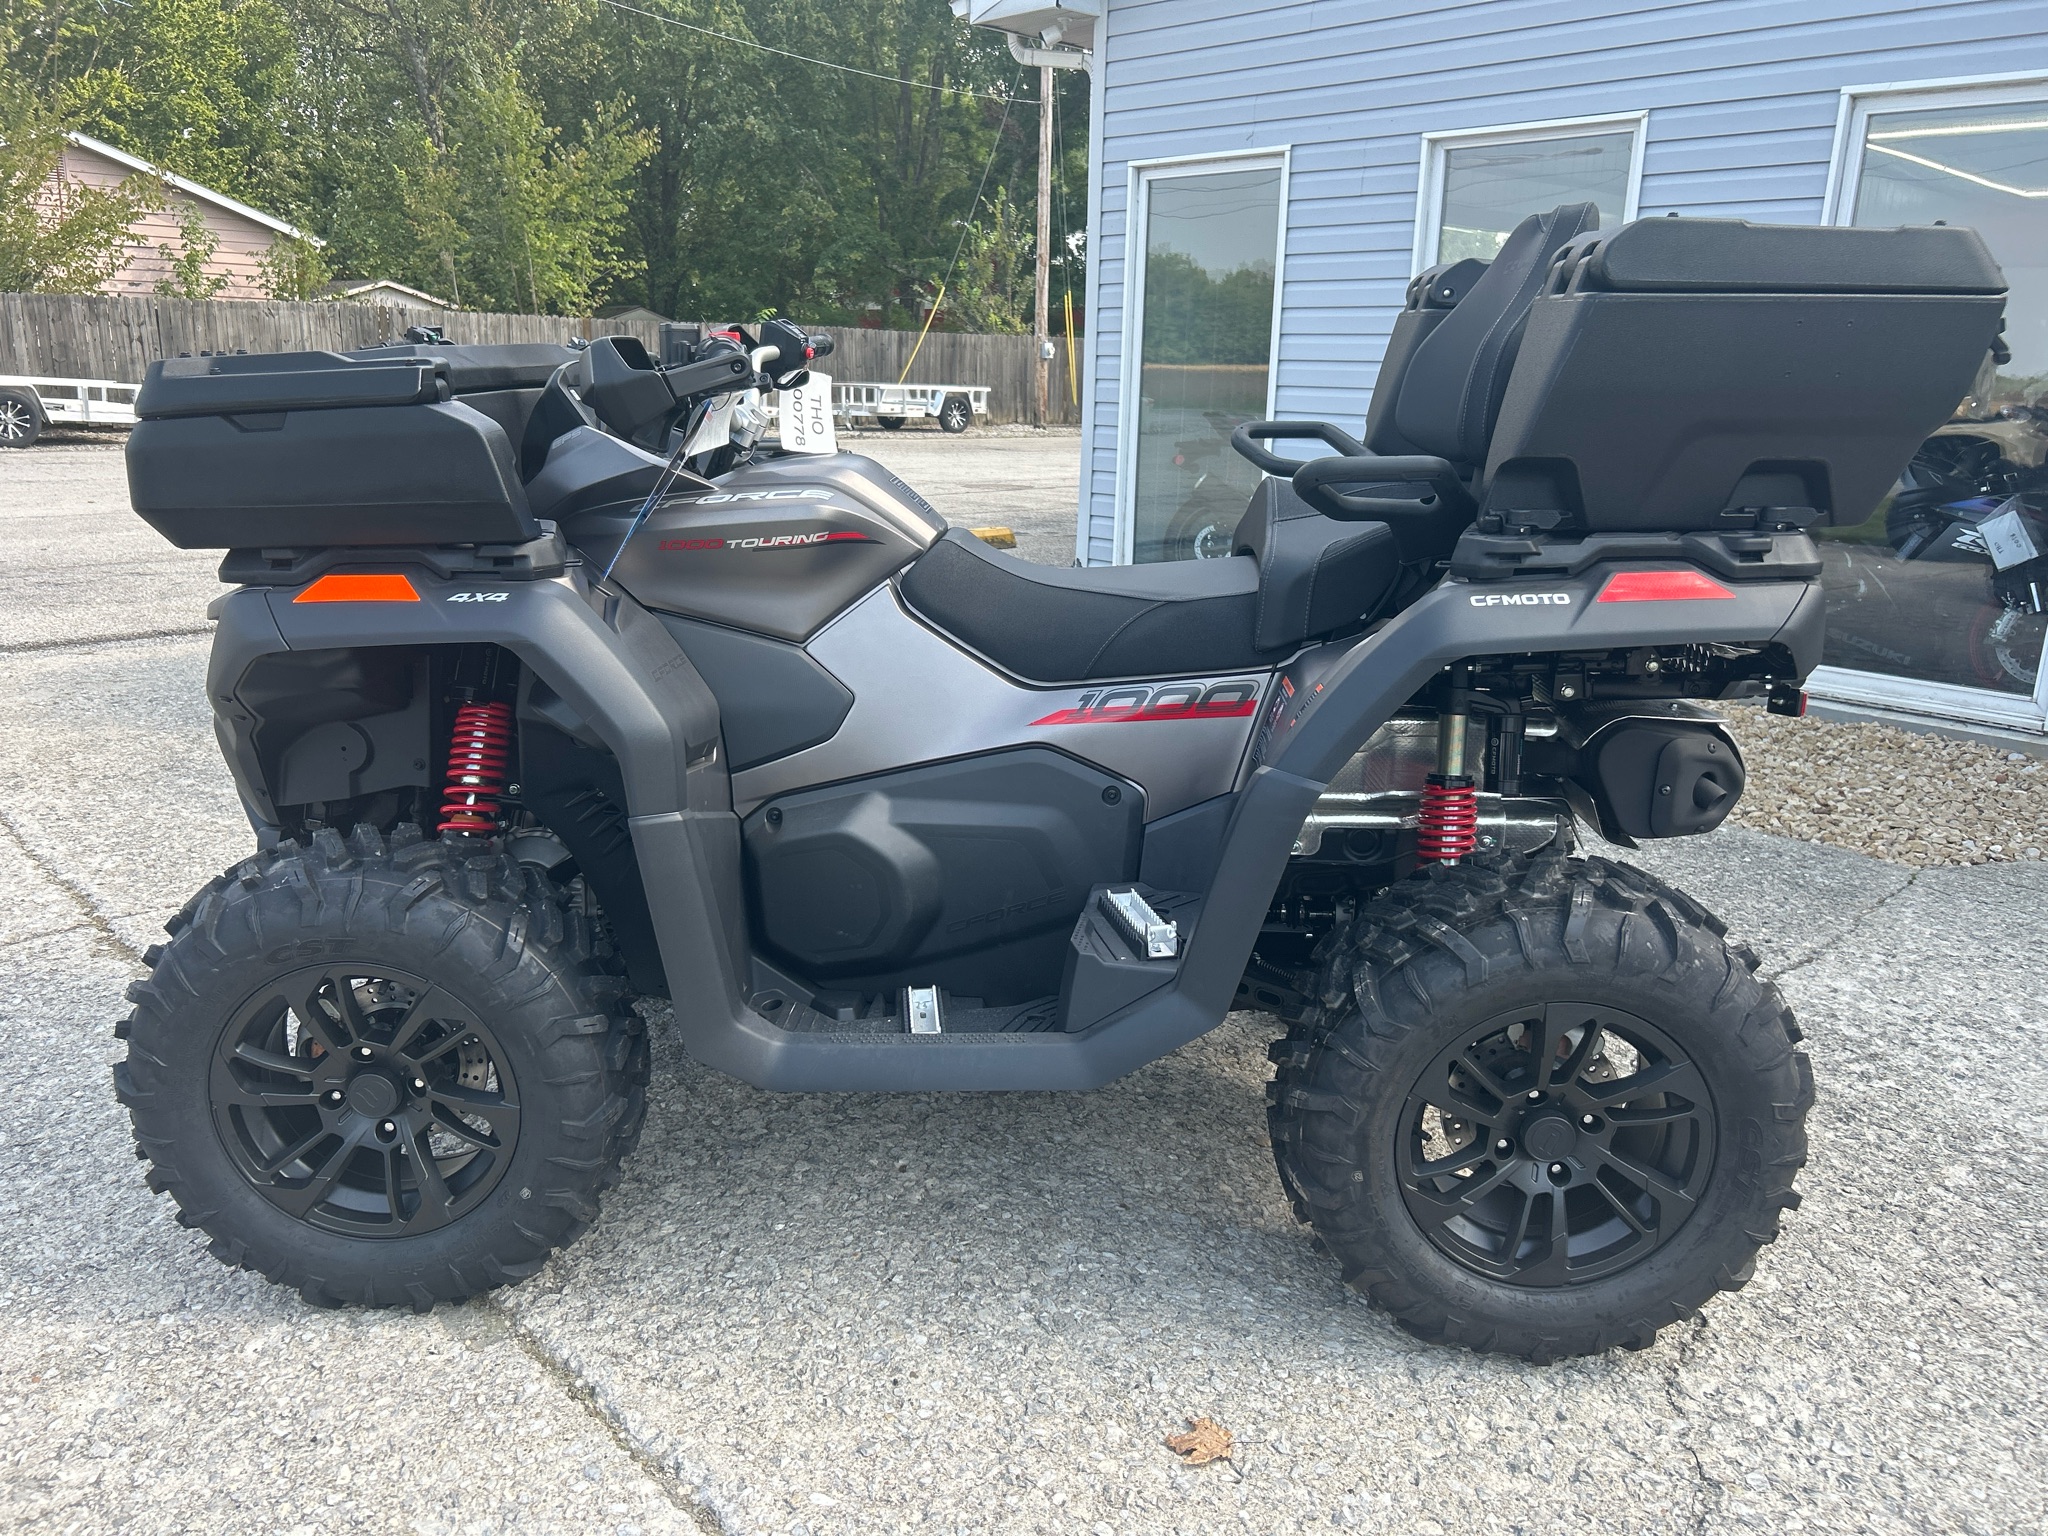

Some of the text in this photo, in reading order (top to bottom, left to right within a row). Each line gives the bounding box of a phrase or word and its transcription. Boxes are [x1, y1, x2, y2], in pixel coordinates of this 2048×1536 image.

[793, 389, 806, 446] 00778
[810, 395, 824, 435] THO
[658, 531, 829, 551] 1000 TOURING
[1469, 593, 1571, 607] CFMOTO
[1066, 680, 1260, 720] 1000
[946, 886, 1068, 934] CFORCE
[264, 937, 358, 966] CST
